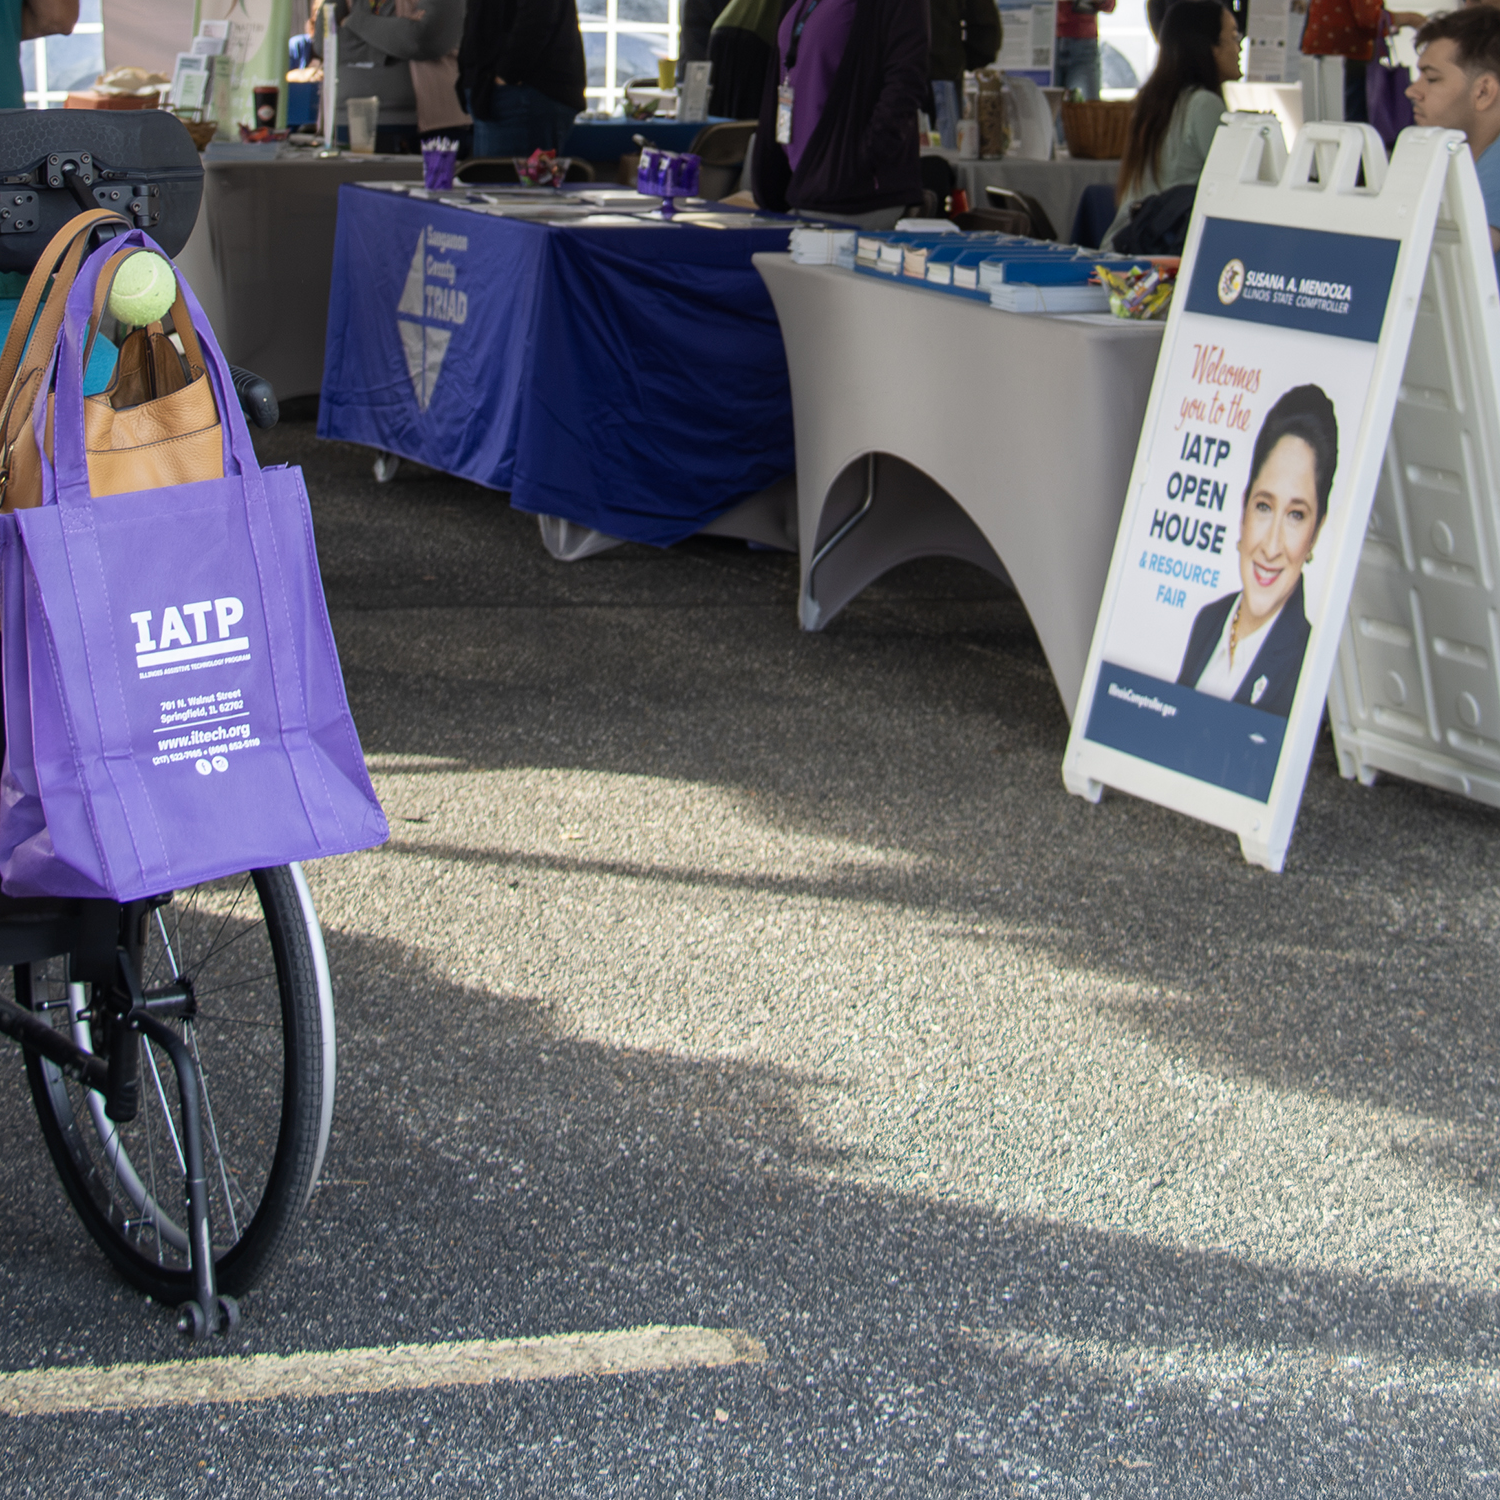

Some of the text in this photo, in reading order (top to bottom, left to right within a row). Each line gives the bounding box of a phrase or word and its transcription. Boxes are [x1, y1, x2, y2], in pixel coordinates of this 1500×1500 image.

[1243, 287, 1350, 315] ILLINOIS STATE COMPTROLLER
[1245, 270, 1353, 301] SUSANA A. MENDOZA
[426, 285, 468, 325] TRIAD
[1191, 344, 1262, 393] Welcomes
[1174, 391, 1251, 432] you to the
[1180, 432, 1231, 468] IATP
[1166, 471, 1228, 512] OPEN
[1149, 508, 1227, 555] HOUSE
[1138, 551, 1220, 589] & RESOURCE
[1156, 584, 1188, 609] FAIR
[130, 596, 244, 653] IATP
[163, 664, 190, 675] ASSISTIVE
[190, 658, 225, 671] TECHNOLOGY
[224, 653, 251, 665] PROGRAM
[160, 689, 242, 712] 701 N. Walnut Street
[160, 700, 244, 724] Springfield, IL 62702
[158, 724, 251, 751] www.iltech.org
